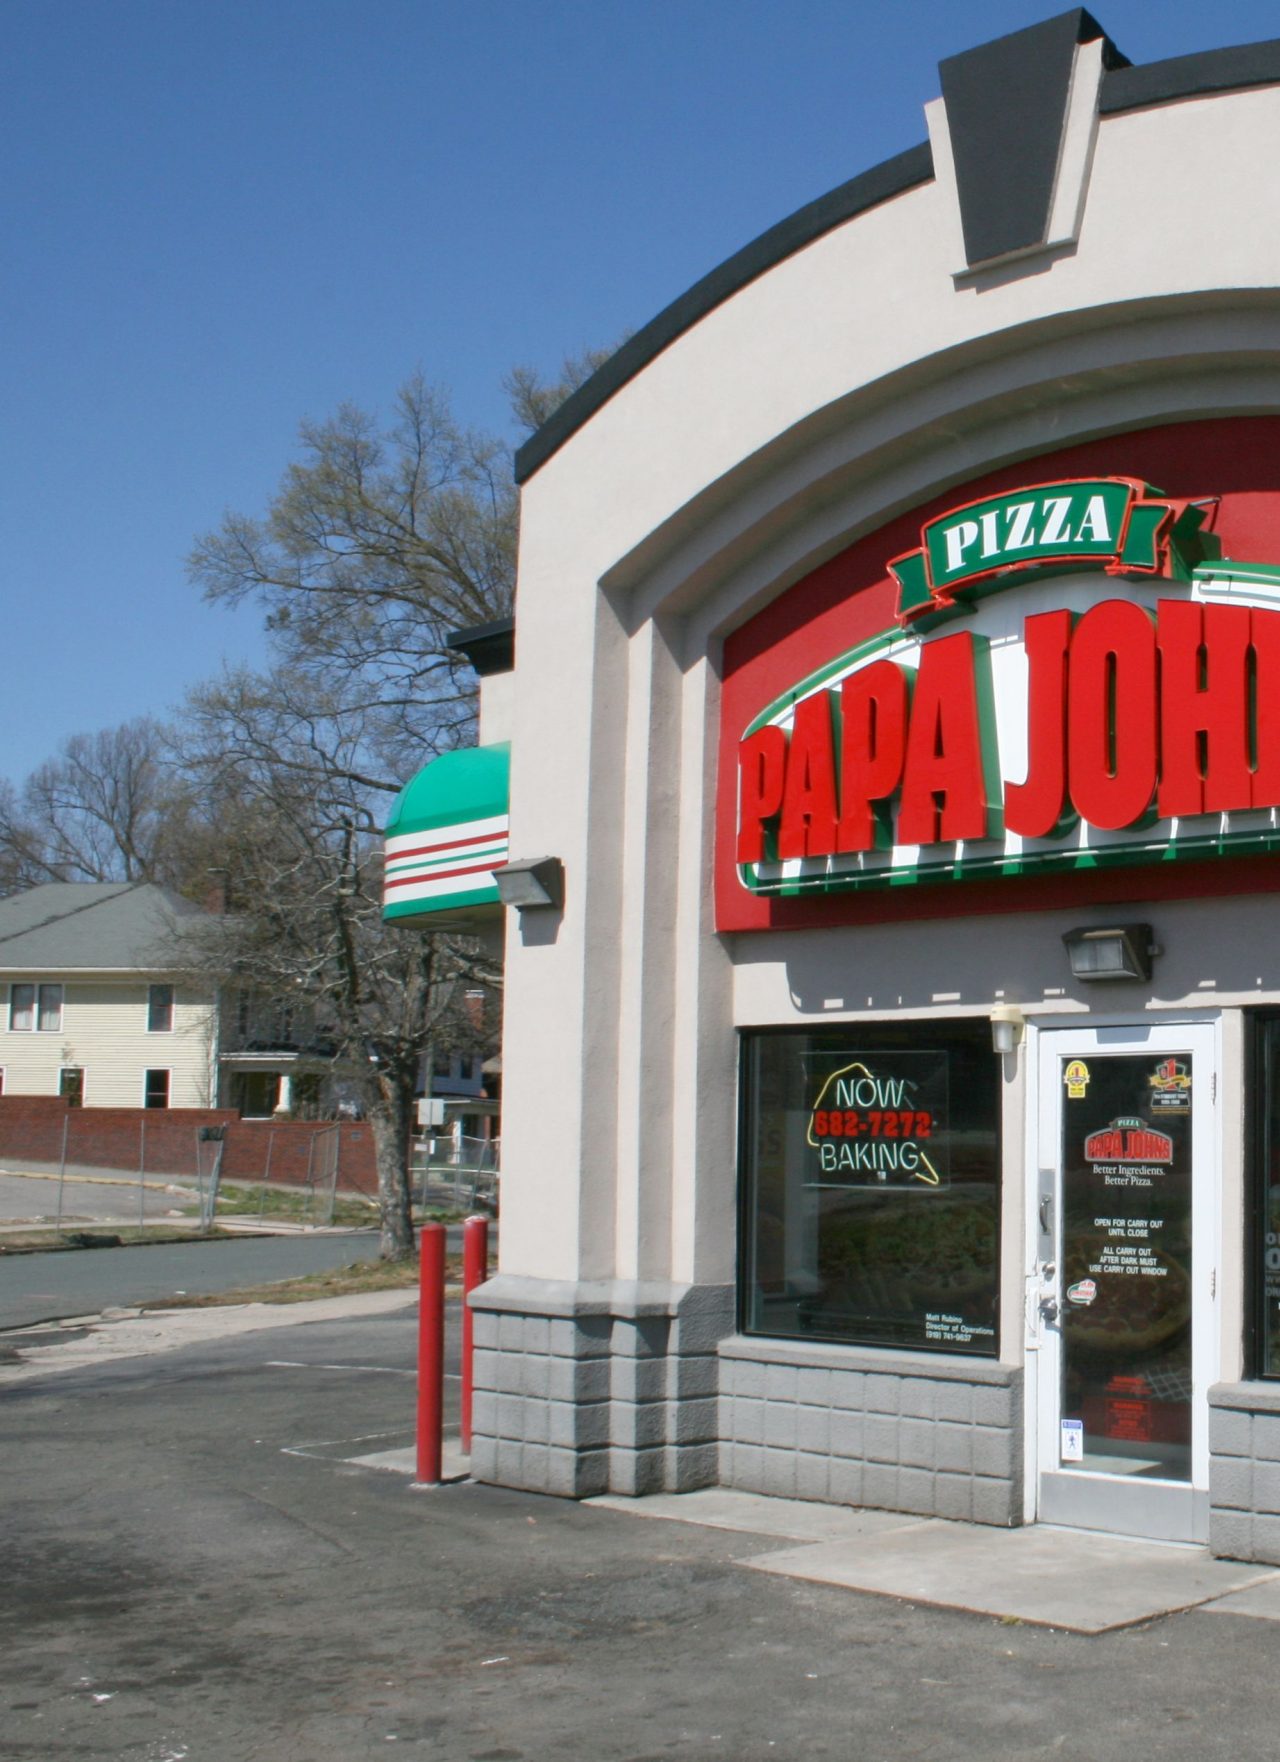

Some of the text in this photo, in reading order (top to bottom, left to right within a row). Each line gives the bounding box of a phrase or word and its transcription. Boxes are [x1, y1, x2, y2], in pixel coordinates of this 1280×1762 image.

[943, 494, 1112, 574] PIZZA
[736, 630, 987, 864] PAPA
[836, 1079, 904, 1108] NOW
[814, 1111, 932, 1138] 682-7272
[1117, 1119, 1139, 1127] PIZZA
[1087, 1131, 1122, 1158] PAPA
[820, 1142, 919, 1171] BAKING
[1093, 1164, 1166, 1177] Better Ingredients.
[1104, 1176, 1153, 1186] Better Pizza.
[1094, 1218, 1163, 1229] OPEN FOR CARRY OUT
[1108, 1228, 1149, 1237] UNTIL CLOSE
[1103, 1246, 1152, 1256] ALL CARRY OUT
[1100, 1256, 1157, 1266] AFTER DARK MUST
[1089, 1264, 1168, 1276] USE CARRY OUT WINDOW
[925, 1321, 950, 1331] Director
